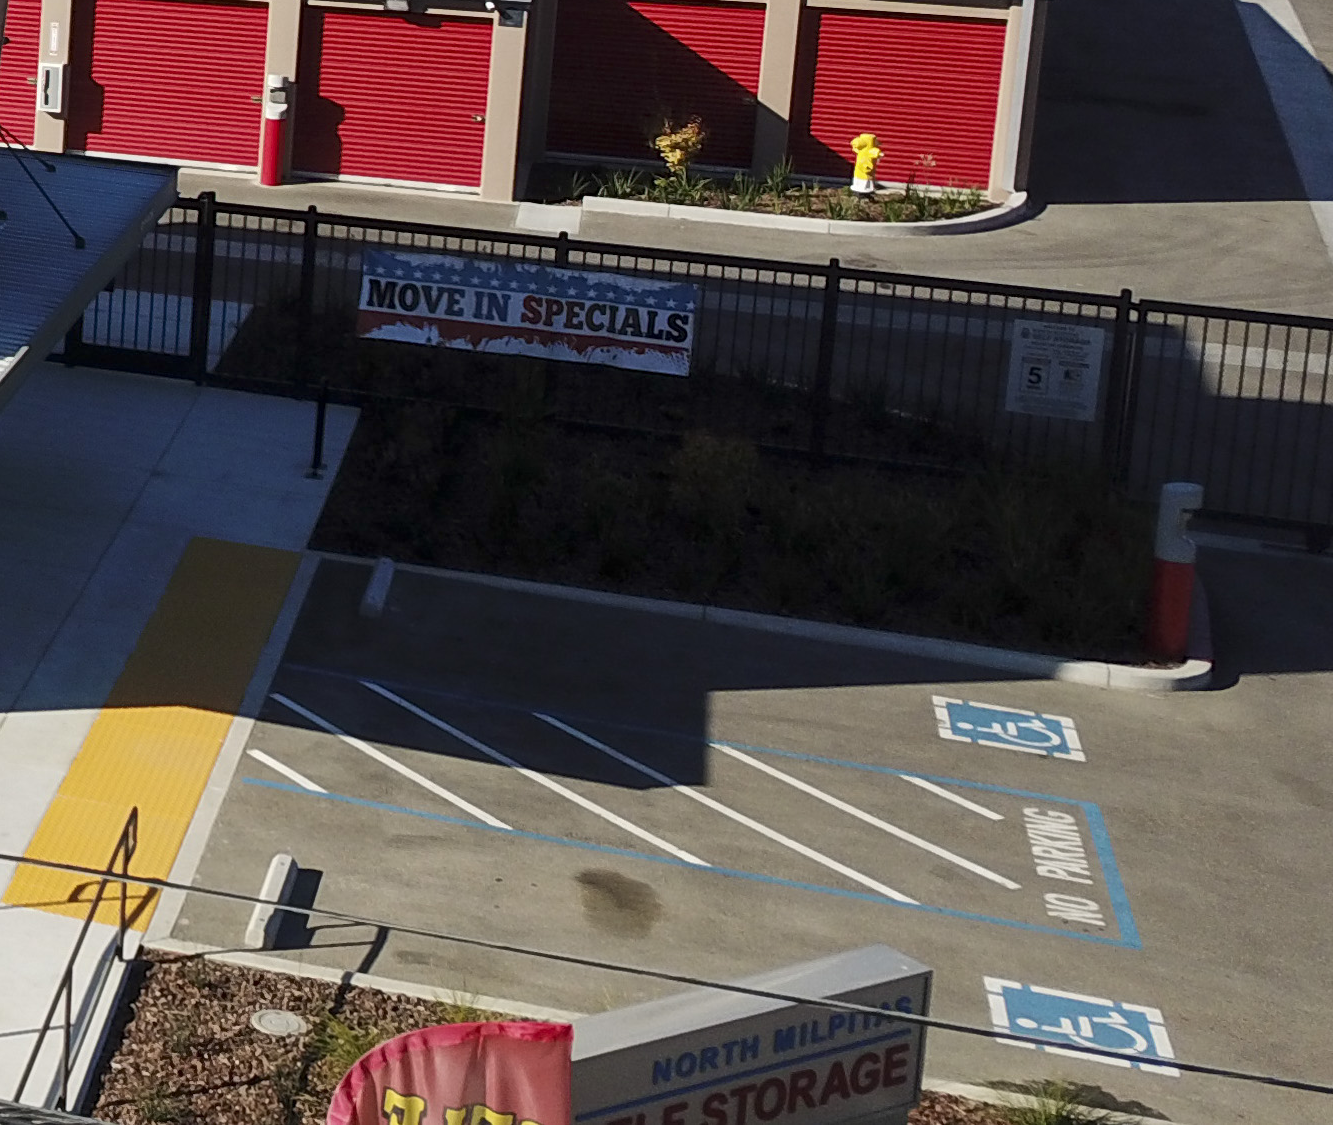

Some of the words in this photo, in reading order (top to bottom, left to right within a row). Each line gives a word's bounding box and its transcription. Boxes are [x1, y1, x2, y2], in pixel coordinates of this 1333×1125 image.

[366, 278, 465, 318] MOVE
[473, 291, 512, 323] IN
[520, 294, 689, 343] SPECIALS
[1027, 366, 1043, 385] 5
[1023, 807, 1094, 885] PARKING
[1043, 892, 1106, 926] NO
[652, 1035, 760, 1085] NORTH
[702, 1043, 910, 1125] STORAGE
